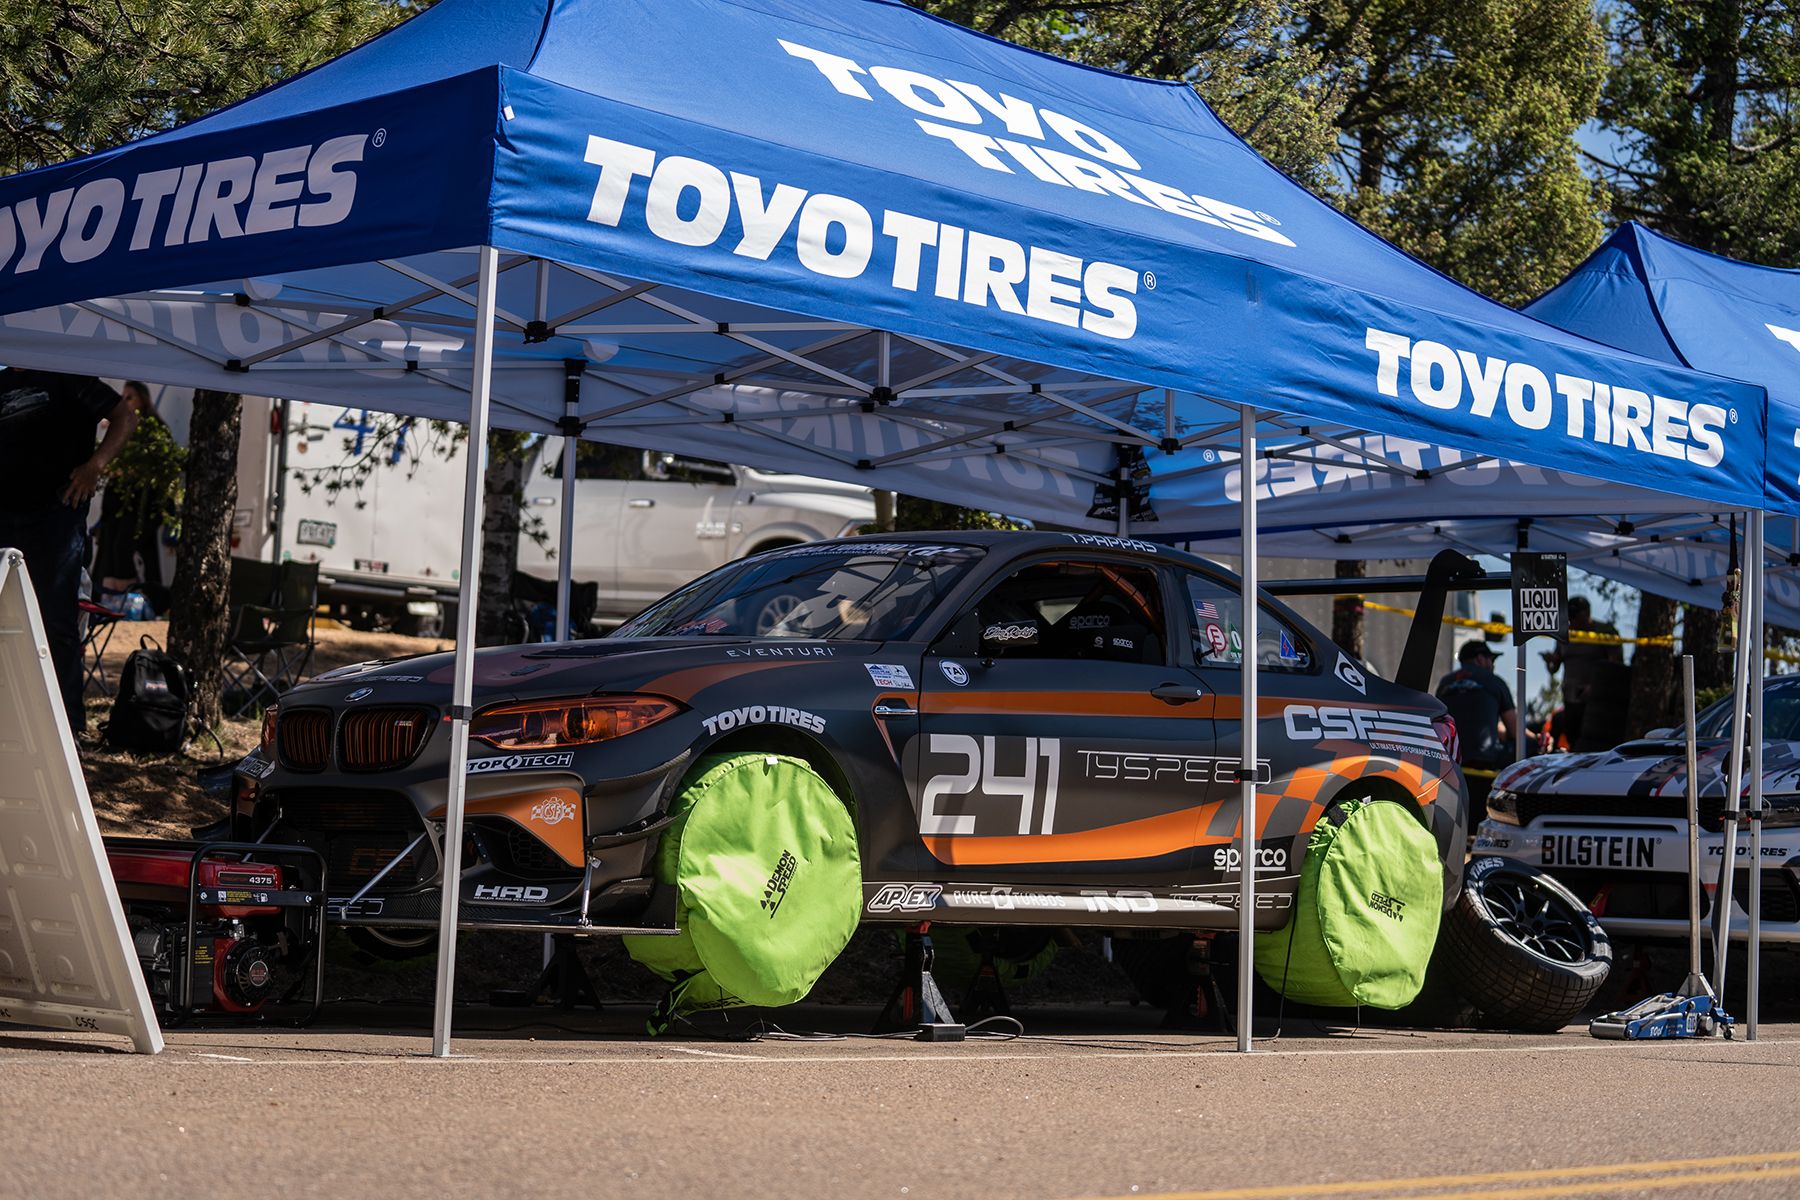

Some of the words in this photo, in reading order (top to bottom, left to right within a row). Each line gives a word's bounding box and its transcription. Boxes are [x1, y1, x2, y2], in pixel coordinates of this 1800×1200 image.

[777, 38, 1141, 170] TOYO
[582, 134, 873, 279] TOYO
[0, 178, 125, 274] YO
[1365, 327, 1552, 430] TOYO
[1522, 590, 1557, 609] LIQUI
[1522, 611, 1559, 630] MOLY
[726, 647, 834, 658] EVENTURI
[943, 666, 965, 676] TAI
[875, 678, 893, 686] TECH
[702, 705, 767, 736] TOYO
[767, 705, 826, 734] TIRES
[1284, 704, 1379, 740] CSF
[1369, 742, 1396, 752] ULTIMATE
[1396, 744, 1431, 758] PERFORMANCE
[1430, 752, 1451, 762] COOLING
[466, 759, 502, 771] TOP
[521, 754, 570, 767] TECH
[919, 733, 1060, 834] 241
[543, 803, 562, 819] CSF
[1213, 848, 1287, 873] sprco
[1541, 835, 1655, 868] BILSTEIN
[1708, 846, 1746, 856] TOO
[766, 849, 791, 892] DEMON
[1470, 856, 1505, 878] TIRES
[249, 876, 273, 885] 4375
[474, 884, 549, 899] HRD
[953, 890, 989, 905] PURE
